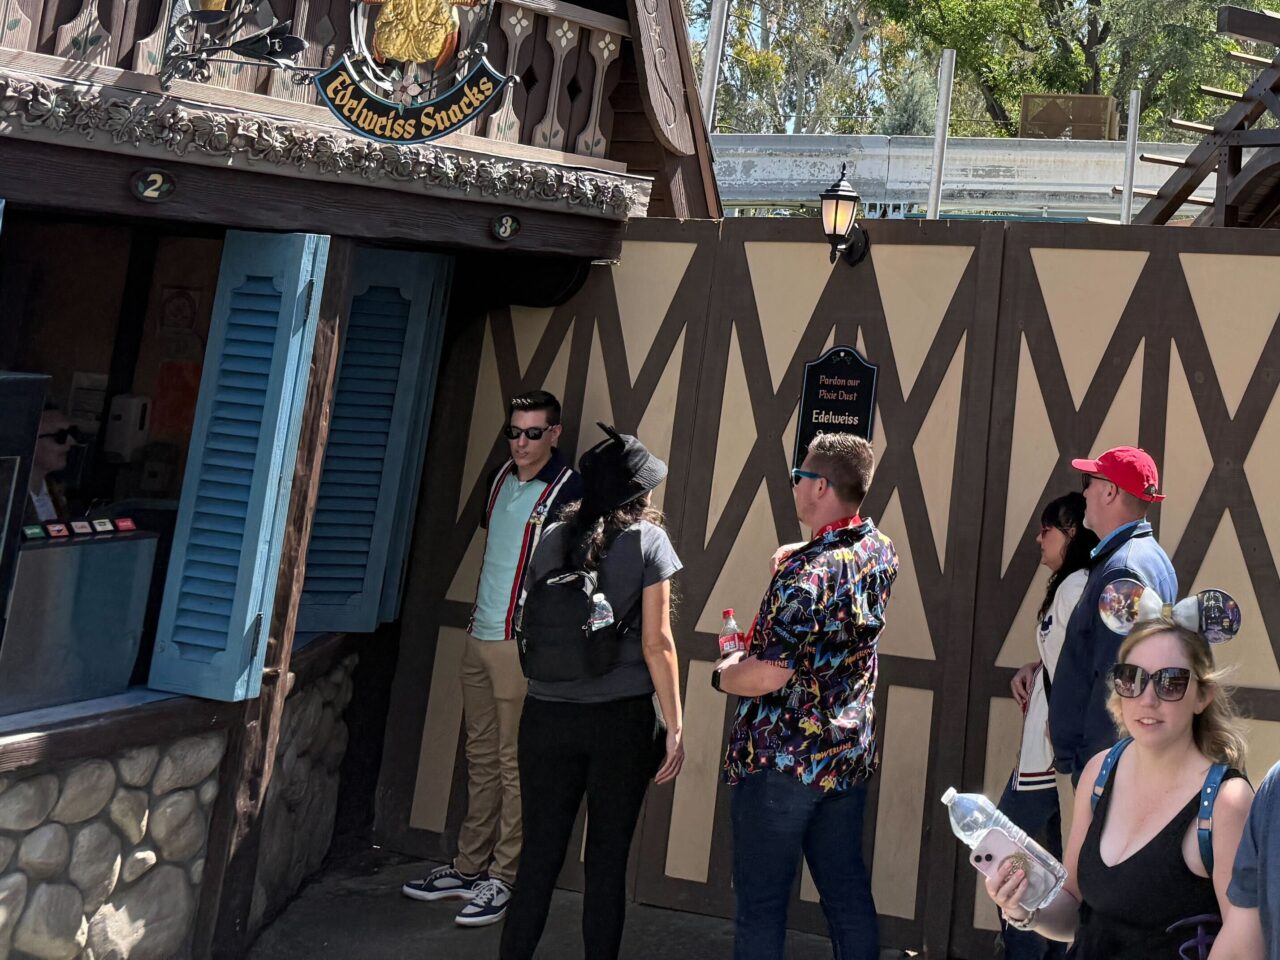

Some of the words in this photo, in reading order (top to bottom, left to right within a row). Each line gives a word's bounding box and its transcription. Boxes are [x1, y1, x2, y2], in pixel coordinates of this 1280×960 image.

[326, 71, 416, 139] Edelweiss
[420, 76, 494, 137] Snacks
[143, 173, 163, 198] 2
[500, 215, 513, 237] 3
[819, 375, 846, 386] Pardon
[846, 378, 861, 387] our
[818, 389, 838, 400] Pixie
[838, 390, 858, 401] Dust
[812, 409, 859, 425] Edelweiss
